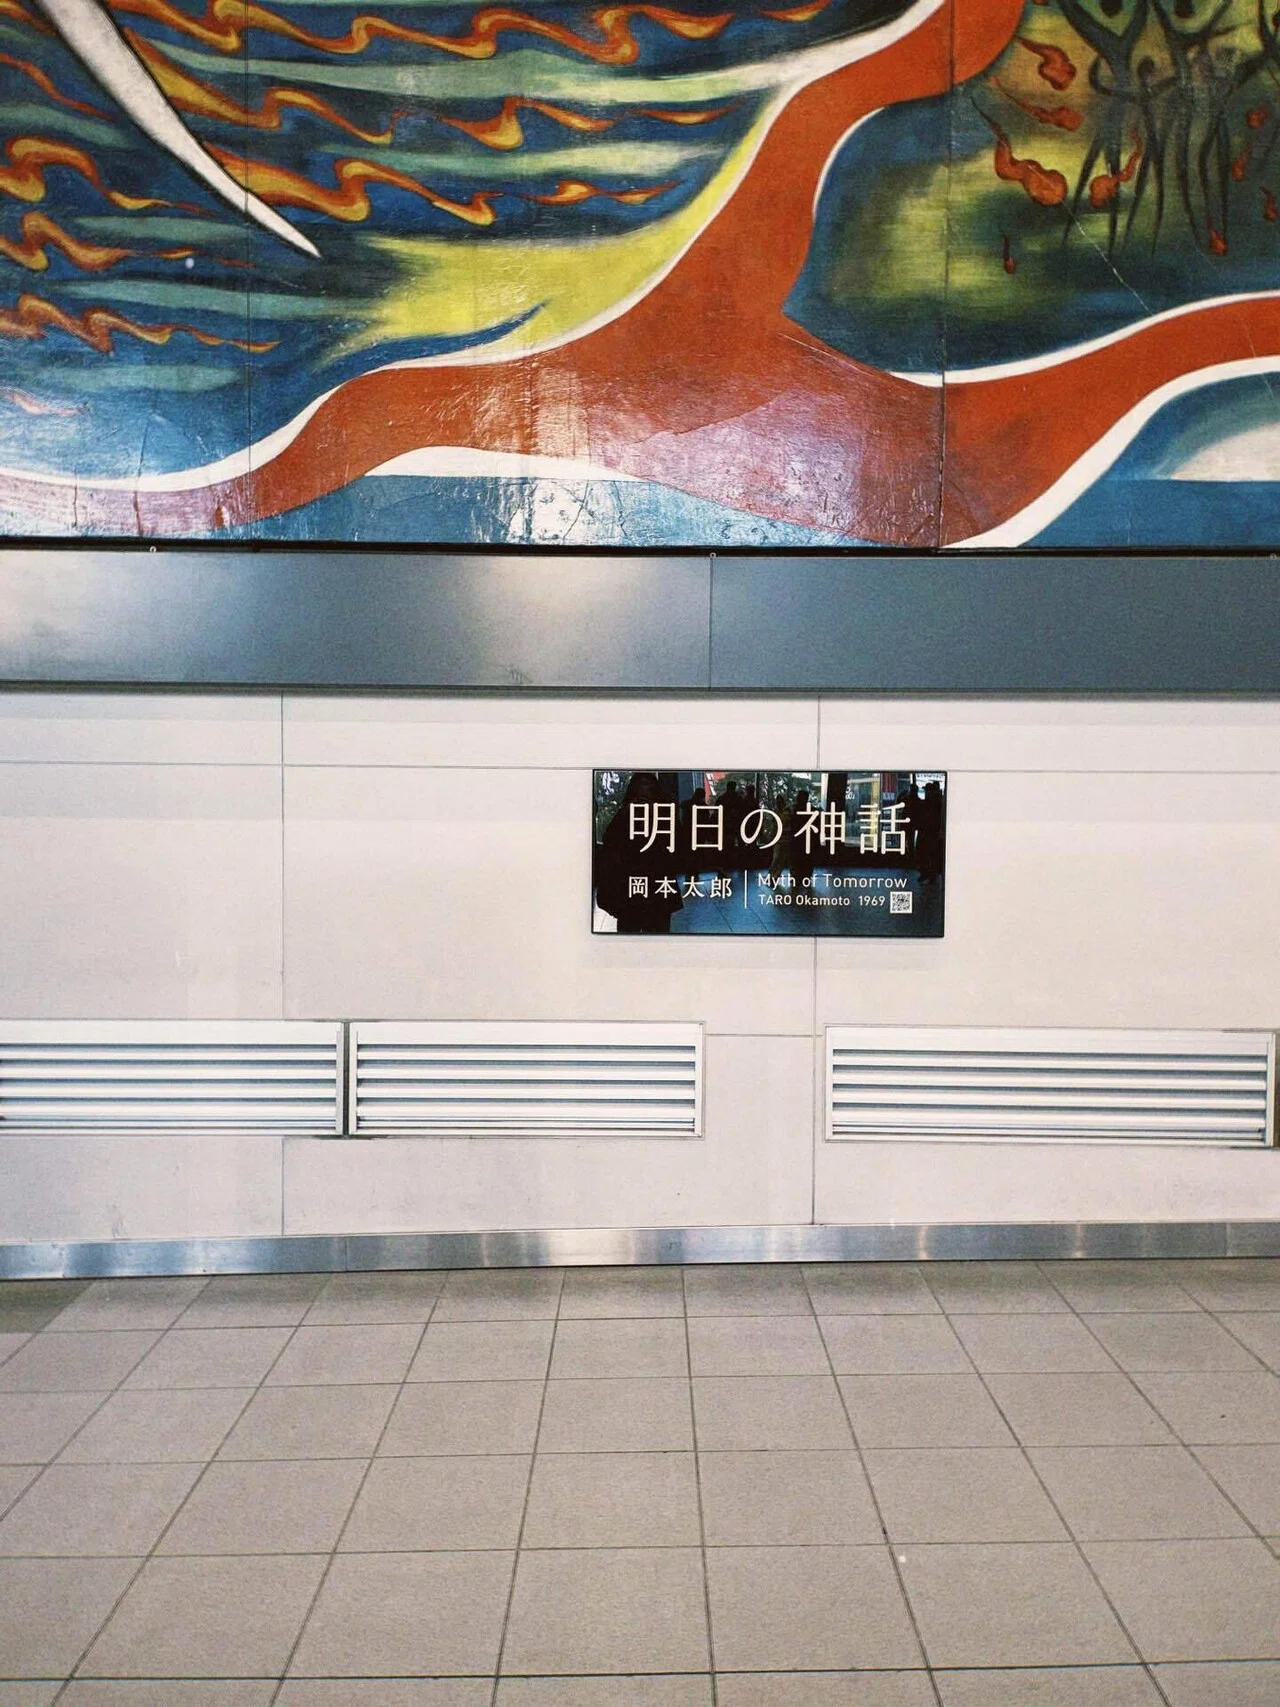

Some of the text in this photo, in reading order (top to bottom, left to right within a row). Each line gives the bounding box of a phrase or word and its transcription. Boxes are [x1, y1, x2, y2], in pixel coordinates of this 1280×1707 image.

[629, 802, 910, 855] 明日の神話
[628, 876, 733, 899] 岡本太郎
[758, 873, 908, 890] Myth of Tomorrow
[758, 894, 886, 907] TARO Okamoto 1969
